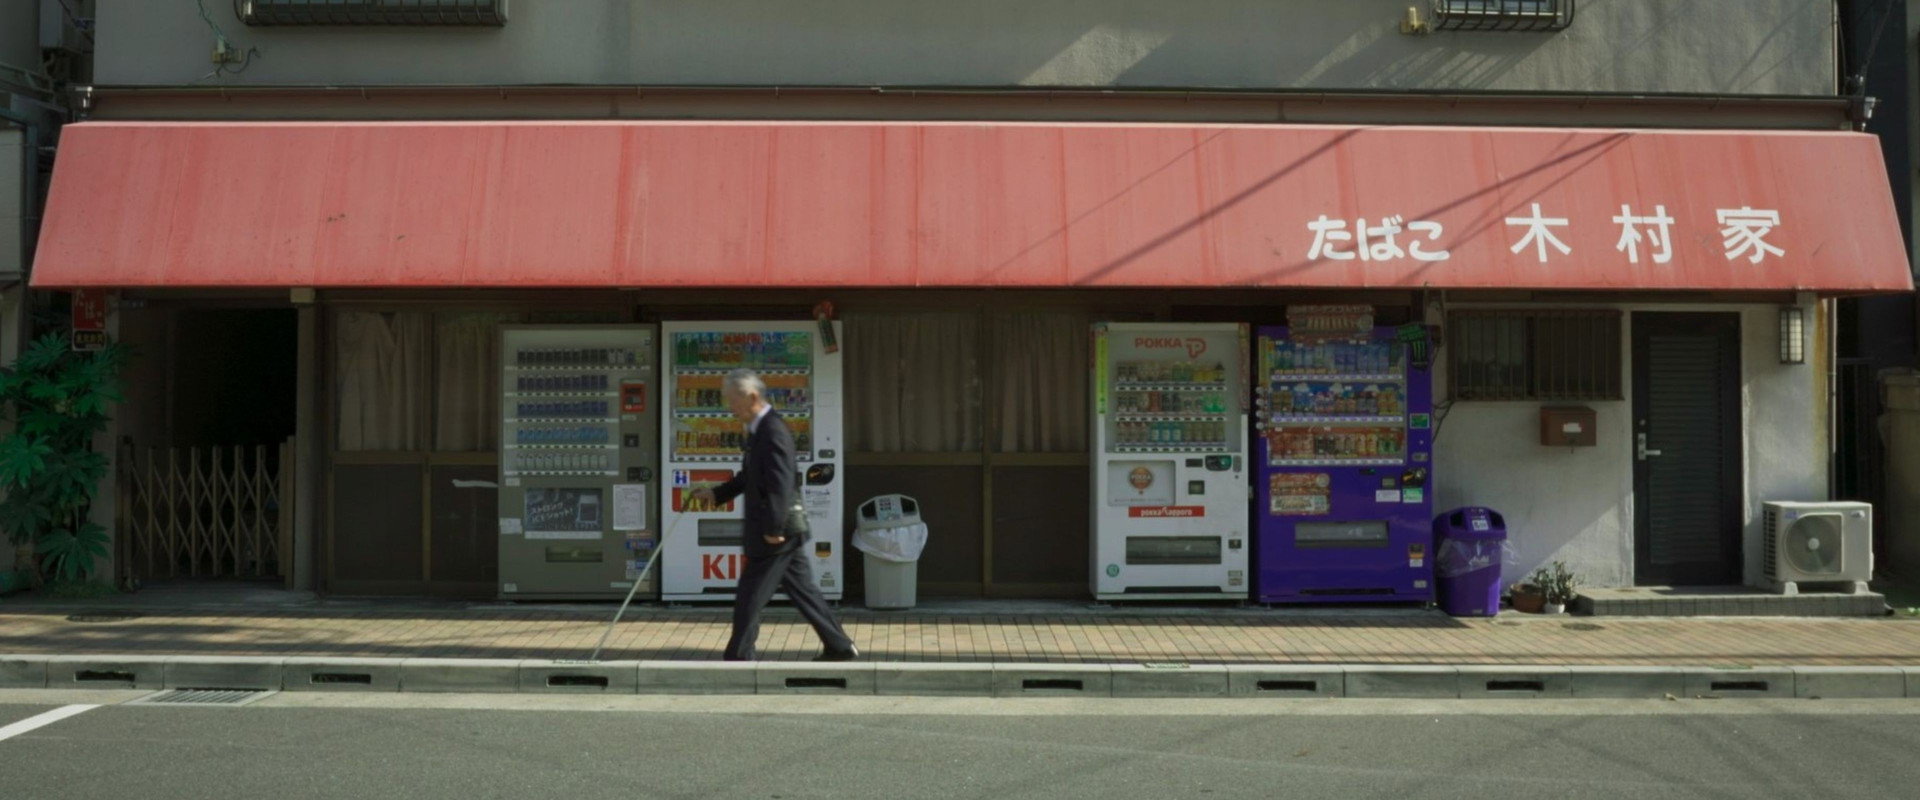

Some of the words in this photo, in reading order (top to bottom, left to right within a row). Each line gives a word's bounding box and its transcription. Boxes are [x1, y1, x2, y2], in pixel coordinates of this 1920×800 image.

[1306, 214, 1451, 261] たばこ
[1504, 203, 1786, 264] 木村家
[1135, 337, 1182, 348] POKKA
